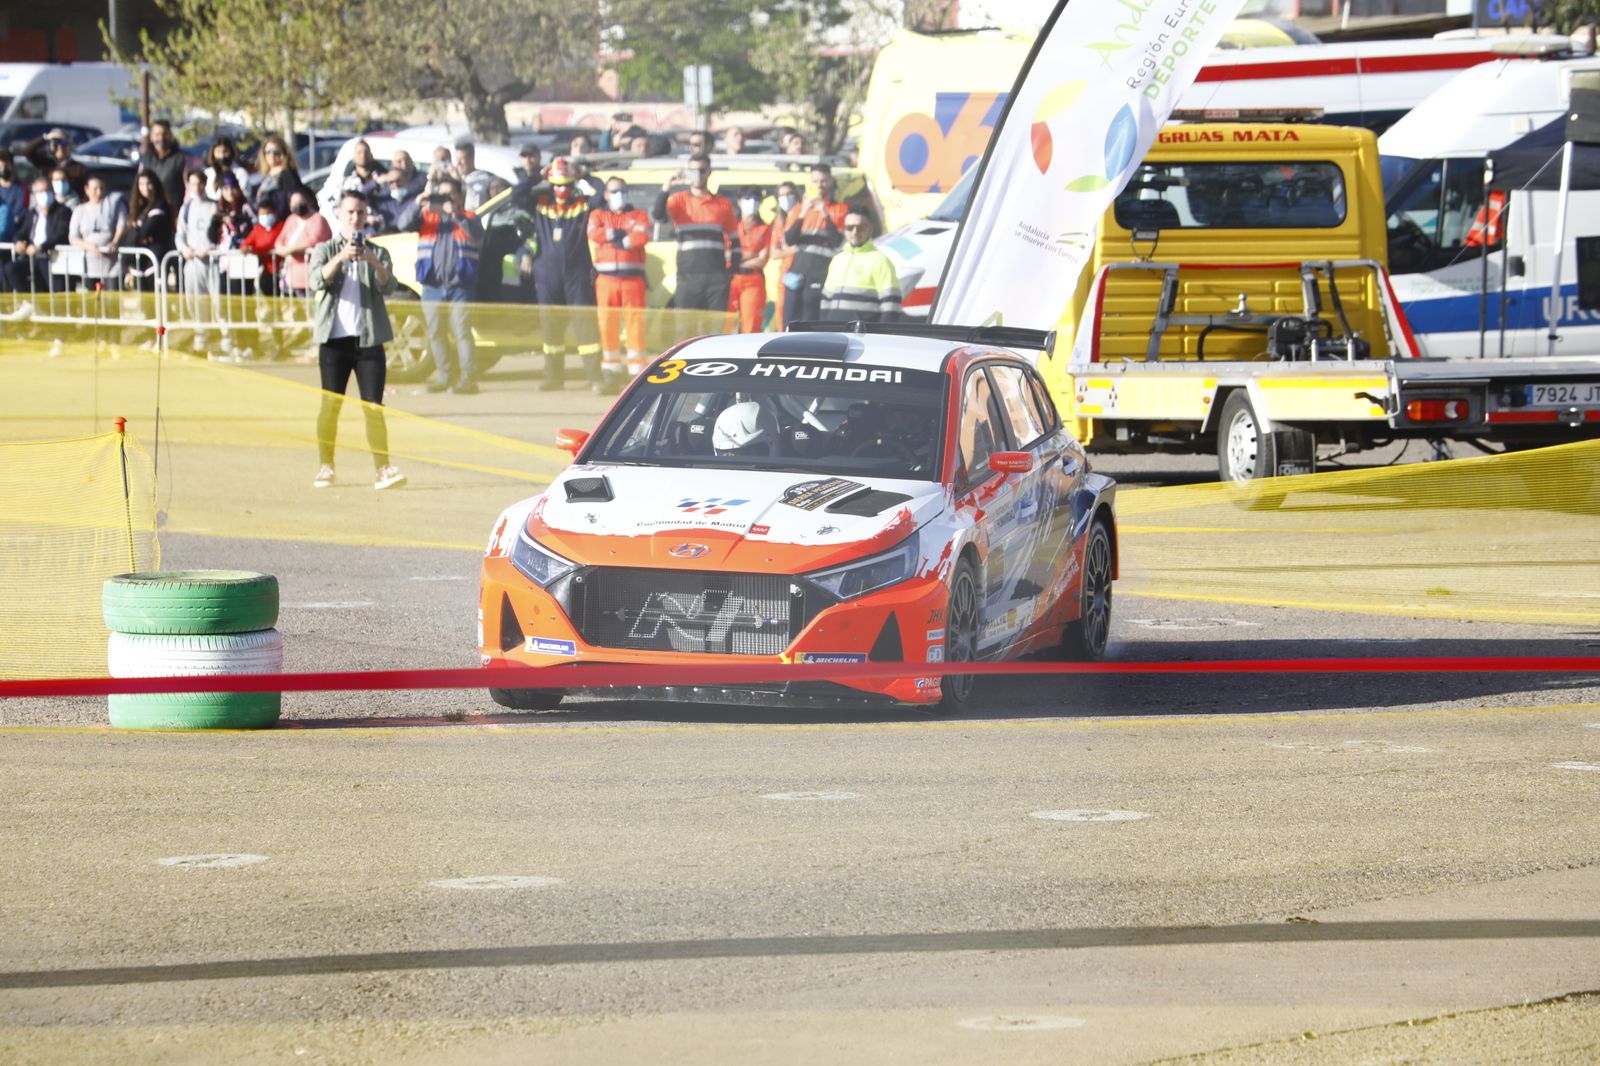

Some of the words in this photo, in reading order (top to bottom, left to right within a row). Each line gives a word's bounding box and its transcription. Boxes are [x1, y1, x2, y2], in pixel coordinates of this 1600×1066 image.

[1143, 0, 1217, 100] DEPORTE
[1126, 33, 1169, 89] Región
[1158, 130, 1225, 144] GRUAS
[1232, 130, 1300, 142] MATA
[647, 359, 688, 384] 3
[750, 363, 902, 384] HYUNDAI
[1536, 386, 1577, 403] 7924
[711, 520, 747, 529] Madrid
[815, 656, 859, 664] MICHELIN
